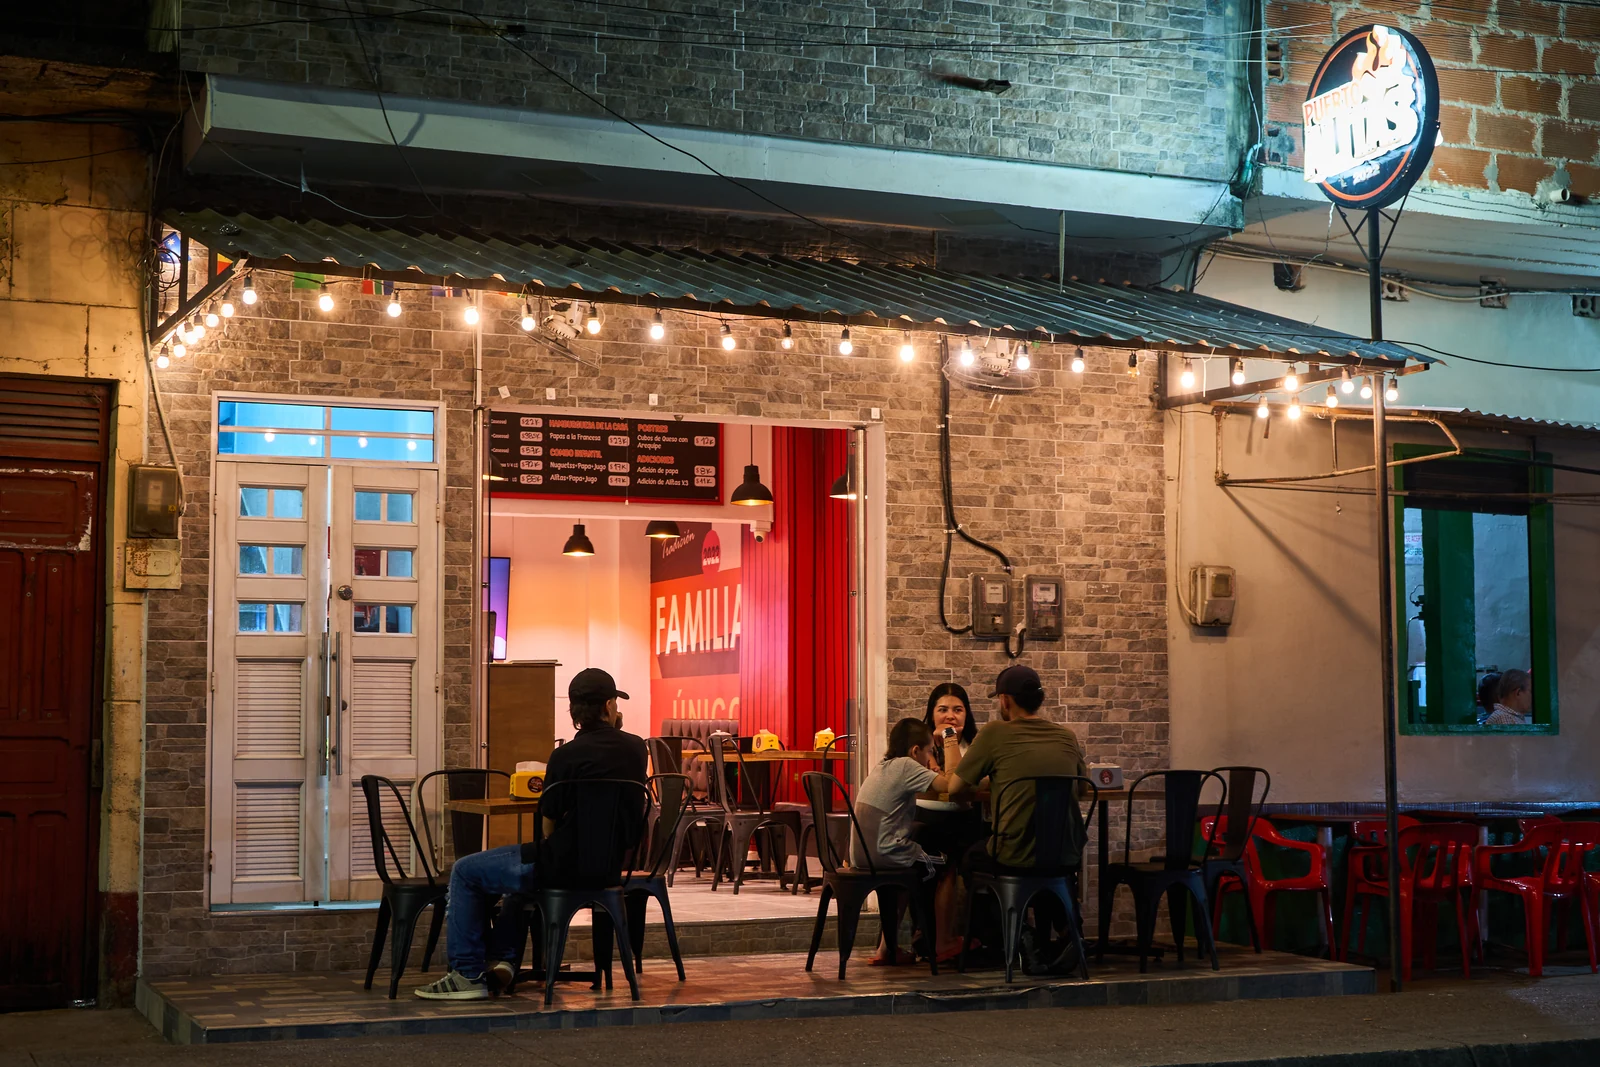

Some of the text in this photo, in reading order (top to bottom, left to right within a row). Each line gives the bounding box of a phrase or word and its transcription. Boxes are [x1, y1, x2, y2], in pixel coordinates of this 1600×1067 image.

[596, 422, 604, 430] DE
[605, 422, 612, 430] LA
[637, 423, 669, 433] POSTRES
[549, 432, 565, 441] Papas
[577, 433, 601, 441] Francesa
[637, 434, 653, 442] Cubos
[661, 435, 678, 443] Queso
[637, 442, 661, 451] Arequipe
[549, 448, 602, 459] COMBO INFANTIL
[636, 455, 675, 464] ADICIONES
[665, 468, 679, 476] papa
[665, 478, 681, 486] Alitas
[661, 529, 695, 559] Tradición
[655, 583, 741, 656] FAMILIA
